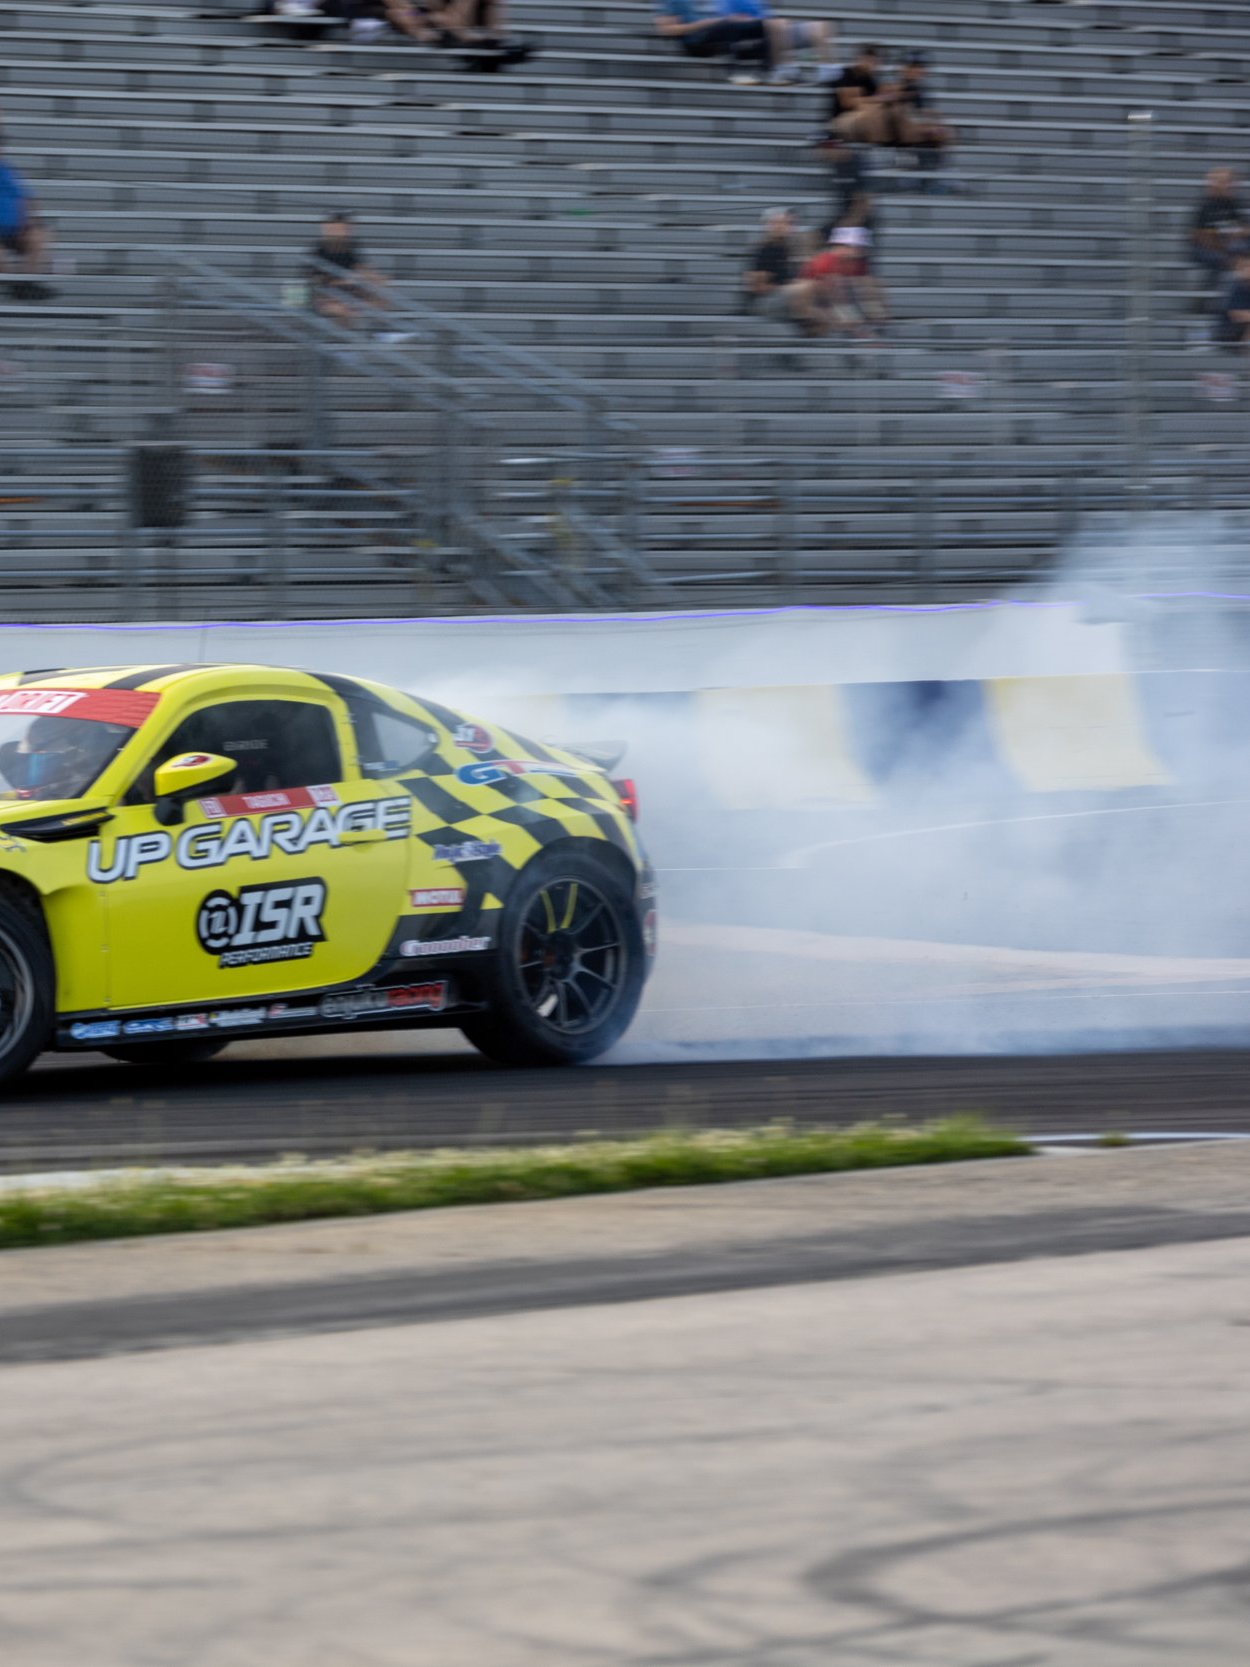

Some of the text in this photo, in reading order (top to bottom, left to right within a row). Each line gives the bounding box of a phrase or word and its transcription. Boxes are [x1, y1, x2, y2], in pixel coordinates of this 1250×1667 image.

[87, 795, 411, 884] UP GARAGE
[230, 884, 325, 946] ISR
